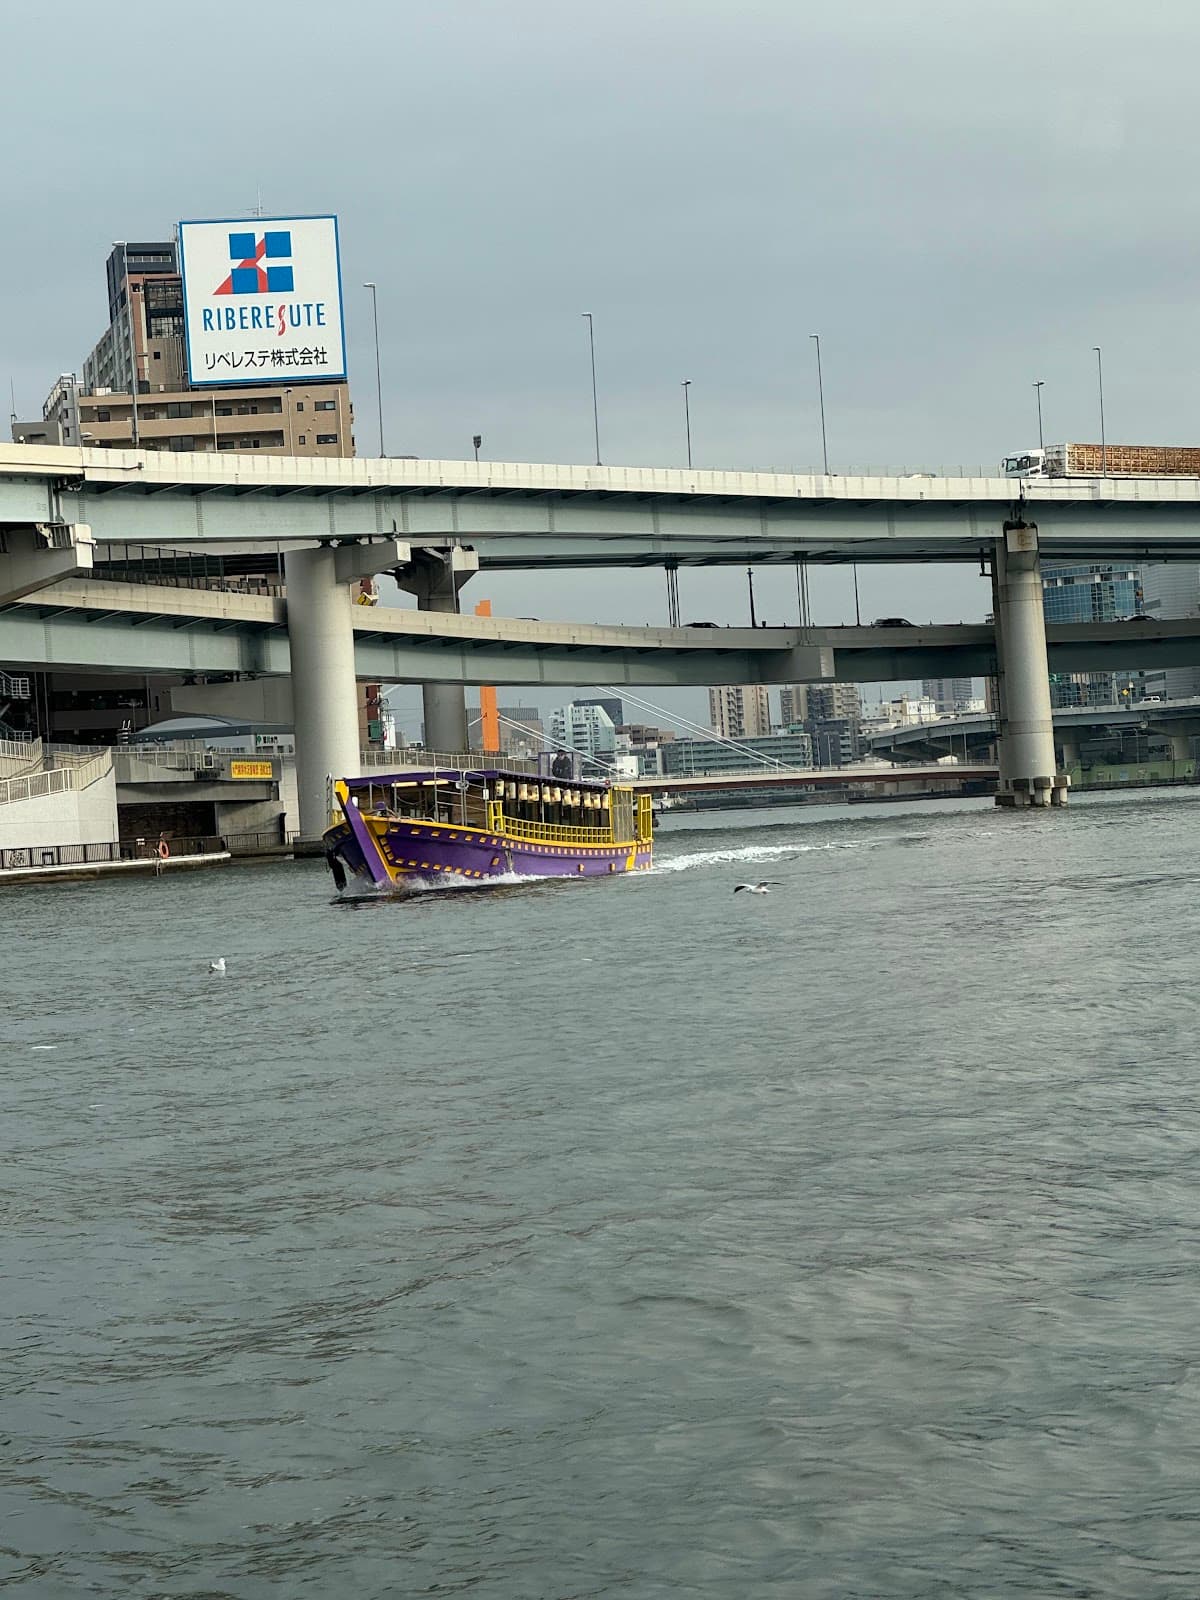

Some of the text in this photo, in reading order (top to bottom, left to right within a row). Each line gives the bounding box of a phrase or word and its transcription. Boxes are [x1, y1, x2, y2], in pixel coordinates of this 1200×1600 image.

[203, 303, 326, 336] RIBERESUTE
[205, 346, 328, 370] リベレステ株式会社
